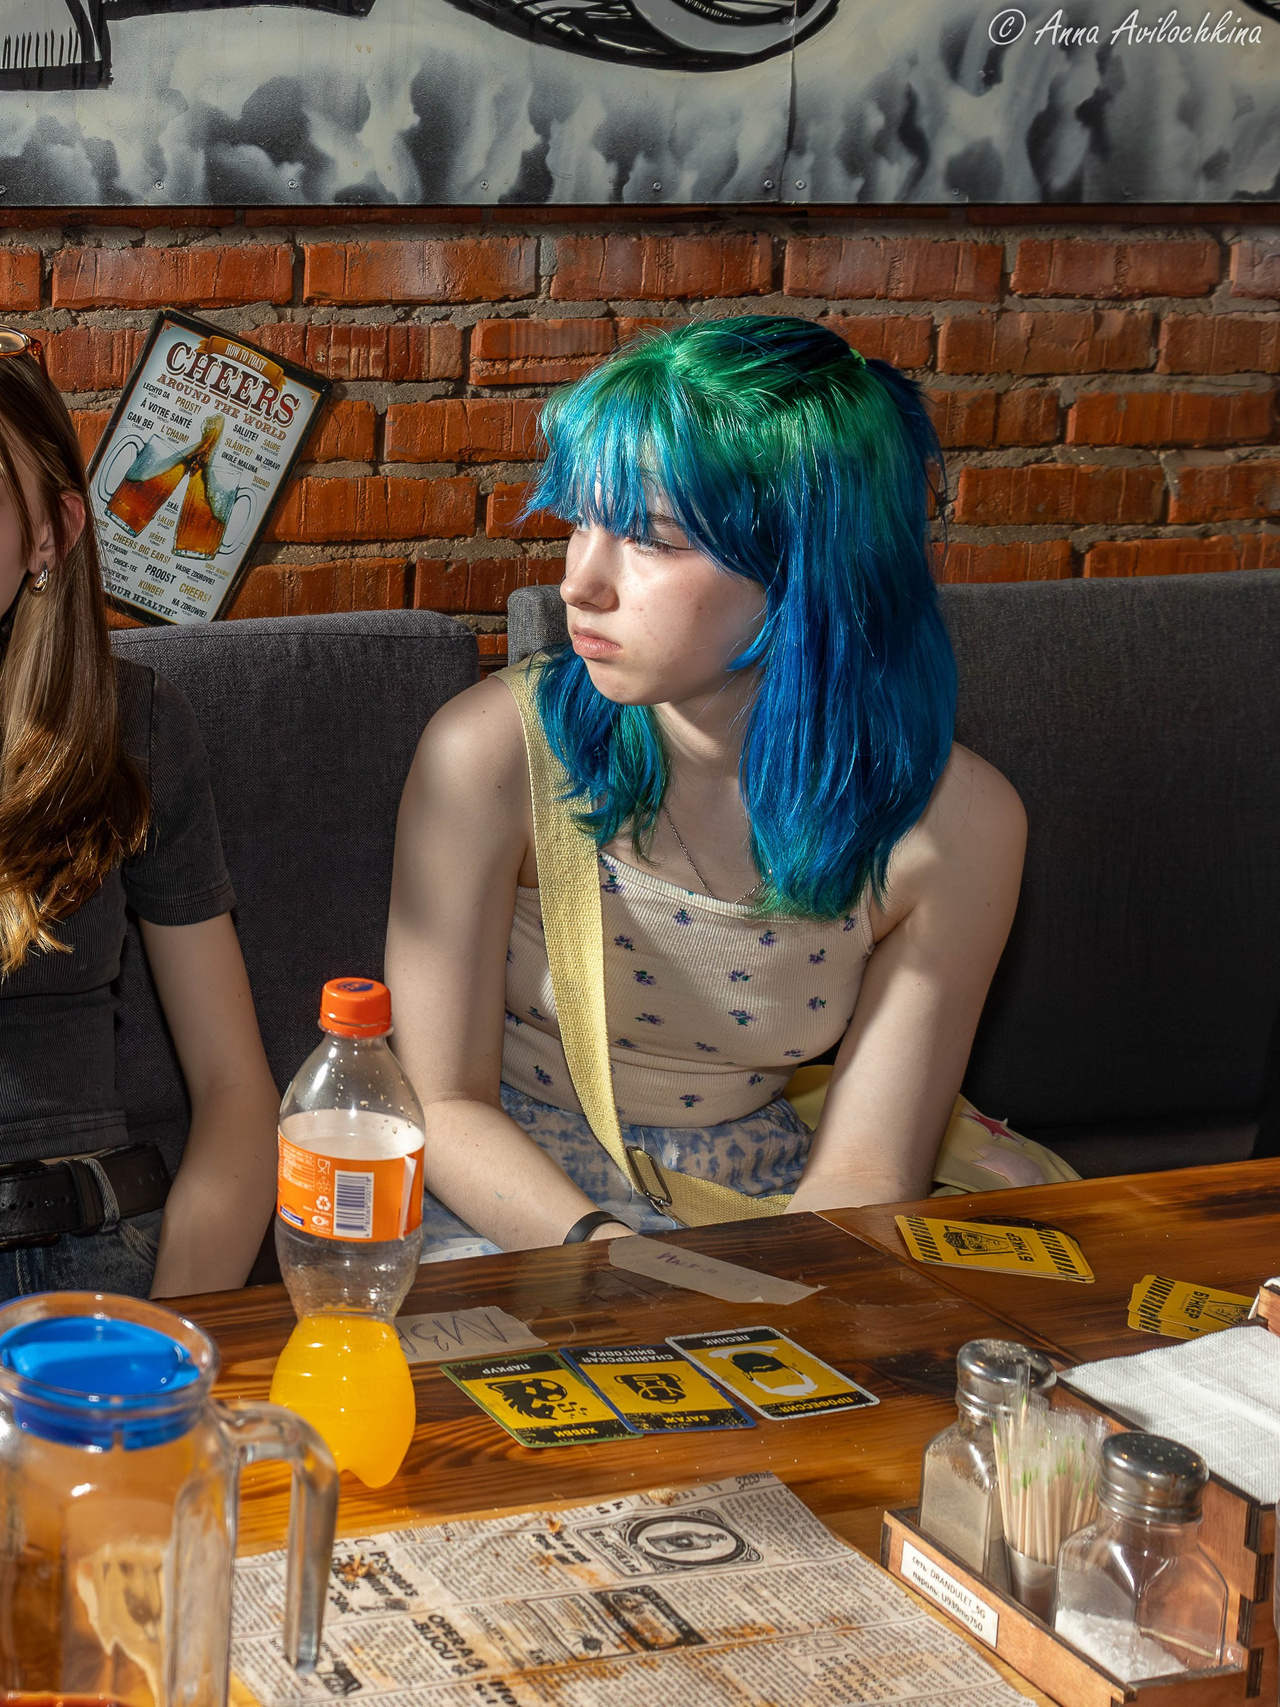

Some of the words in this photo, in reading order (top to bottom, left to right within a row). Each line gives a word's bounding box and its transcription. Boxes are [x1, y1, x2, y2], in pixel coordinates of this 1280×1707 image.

[225, 343, 240, 357] HOW
[239, 348, 249, 361] TO
[247, 353, 267, 371] TOAST
[167, 342, 298, 426] CHEERS
[148, 401, 169, 418] VOTRE
[169, 412, 192, 428] SANTÉ
[157, 374, 210, 403] AROUND
[214, 399, 240, 418] THE
[243, 413, 286, 440] WORLD
[126, 411, 142, 423] GAN
[141, 418, 154, 429] BEI
[232, 424, 258, 441] SALUTE!
[112, 532, 138, 549] CHEERS
[138, 544, 150, 555] BIG
[150, 549, 170, 564] EARS!
[144, 564, 176, 583] PROOST
[175, 562, 191, 574] VASHE
[179, 583, 211, 602] CHEERS!
[171, 597, 180, 606] NA
[180, 601, 207, 618] ZDROWIE!
[1005, 1231, 1036, 1263] БУНКЕР
[1182, 1290, 1211, 1320] БУНКЕР
[701, 1332, 751, 1347] ЛЕСНИК
[581, 1352, 675, 1365] СНАЙПЕРСКАЯ
[586, 1348, 657, 1359] ВИНТОВКА
[481, 1362, 532, 1376] ПАРКУР
[777, 1394, 855, 1414] ПРОФЕССИЯ
[661, 1413, 711, 1426] БАГАЖ
[552, 1426, 599, 1440] ХОББИ
[427, 1614, 475, 1658] OPERA
